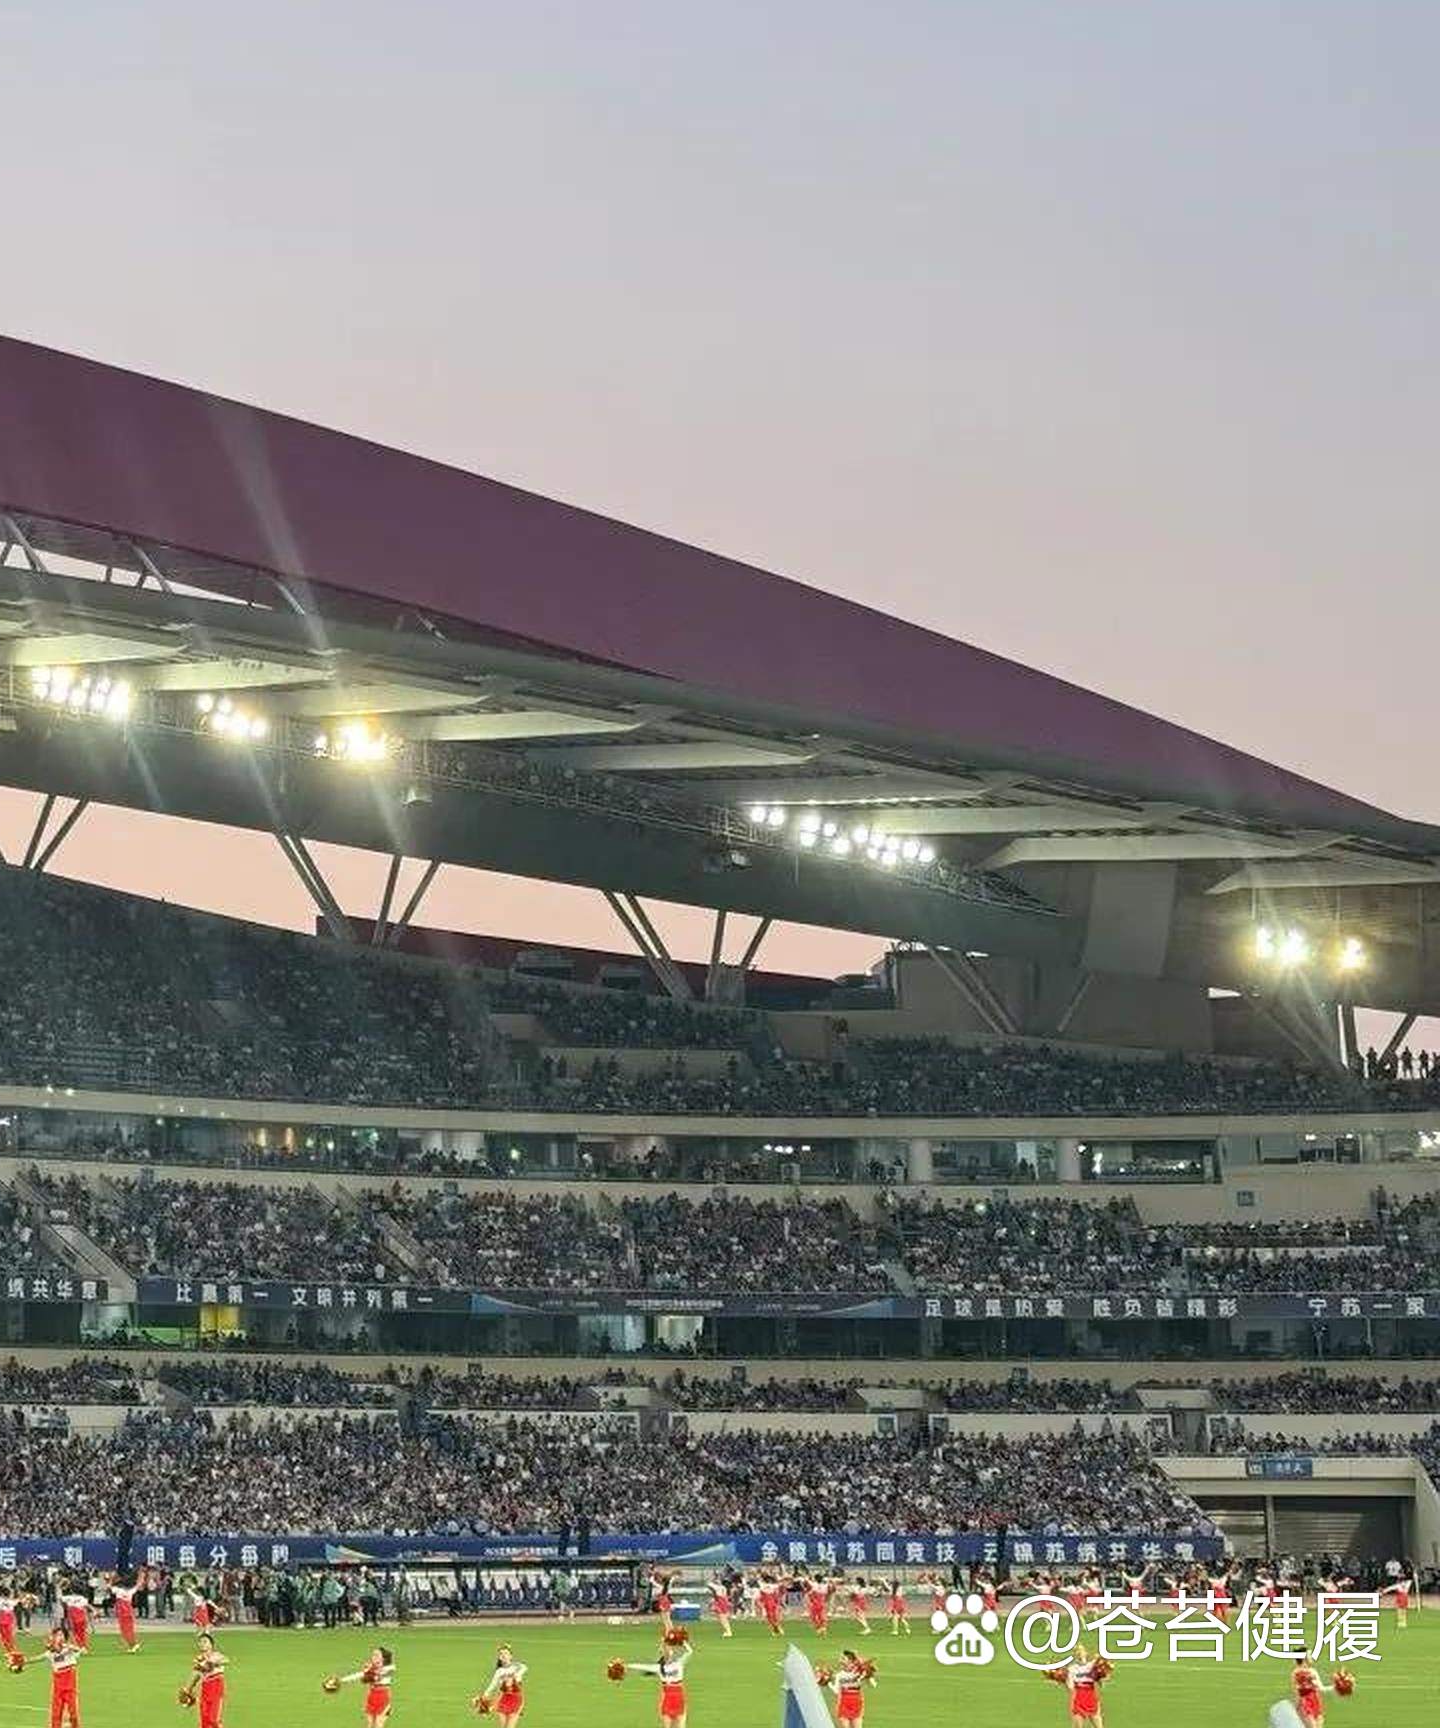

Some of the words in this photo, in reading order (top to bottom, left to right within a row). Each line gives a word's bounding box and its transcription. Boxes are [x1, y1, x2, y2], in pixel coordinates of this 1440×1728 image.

[761, 1541, 957, 1566] 金陵姑苏同竞技
